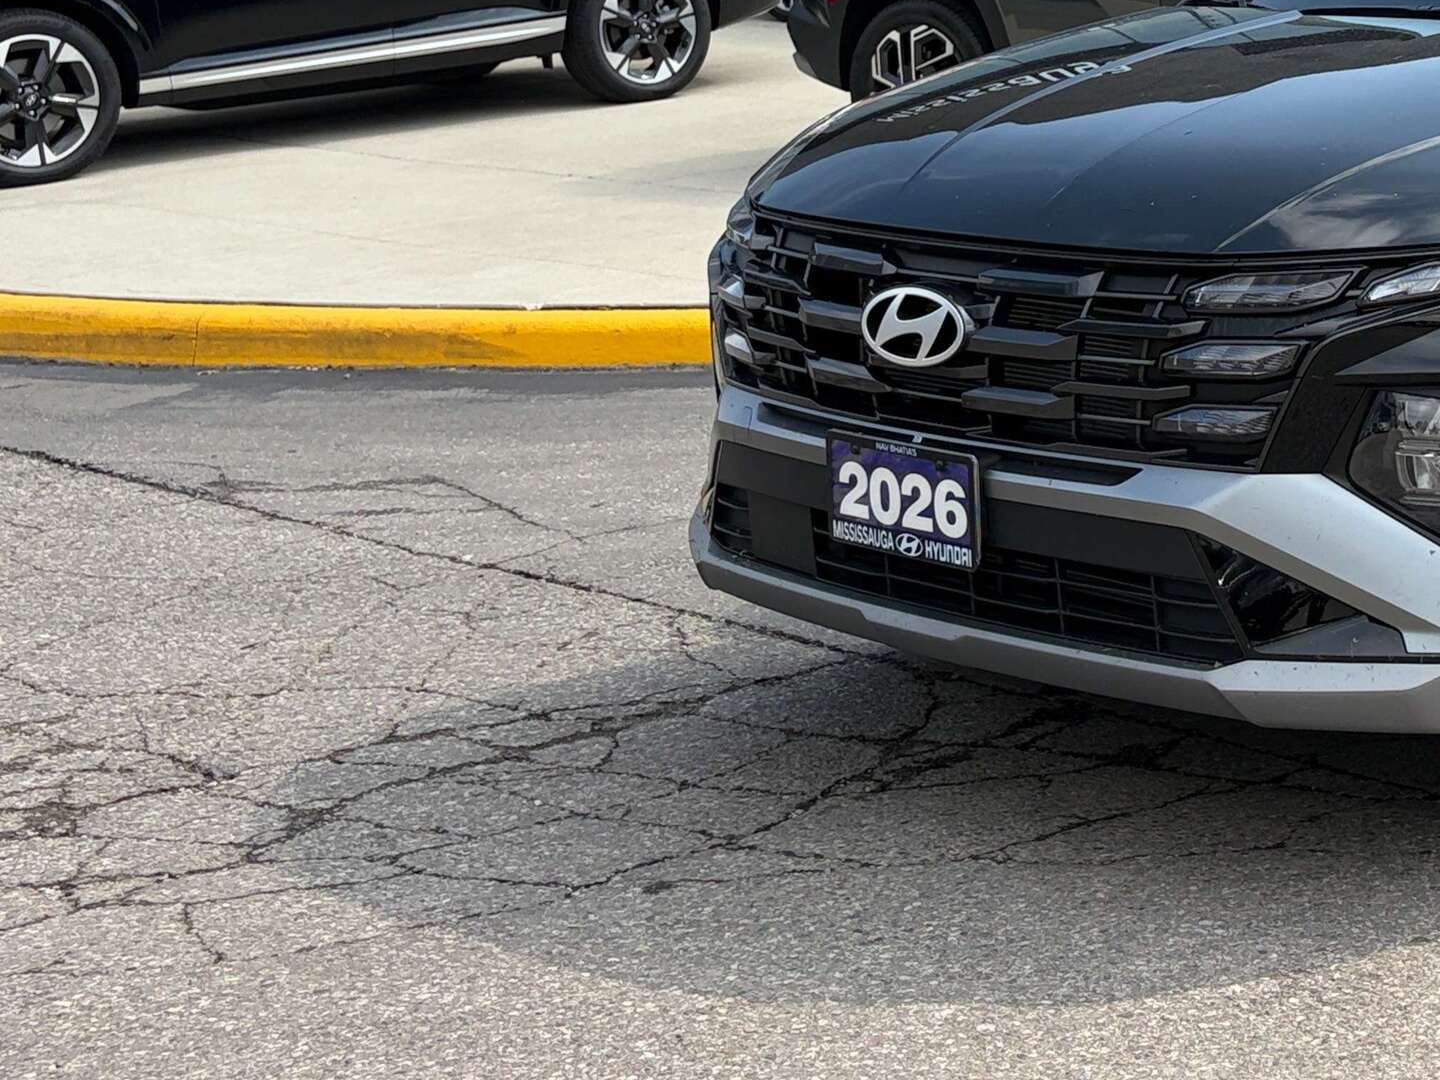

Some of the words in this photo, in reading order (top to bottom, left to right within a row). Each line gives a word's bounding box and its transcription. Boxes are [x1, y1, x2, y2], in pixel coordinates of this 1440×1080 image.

[875, 441, 889, 451] NAV
[838, 460, 968, 539] 2026
[832, 519, 895, 551] MISSISSAUGA
[924, 539, 973, 568] HYUNDAI
